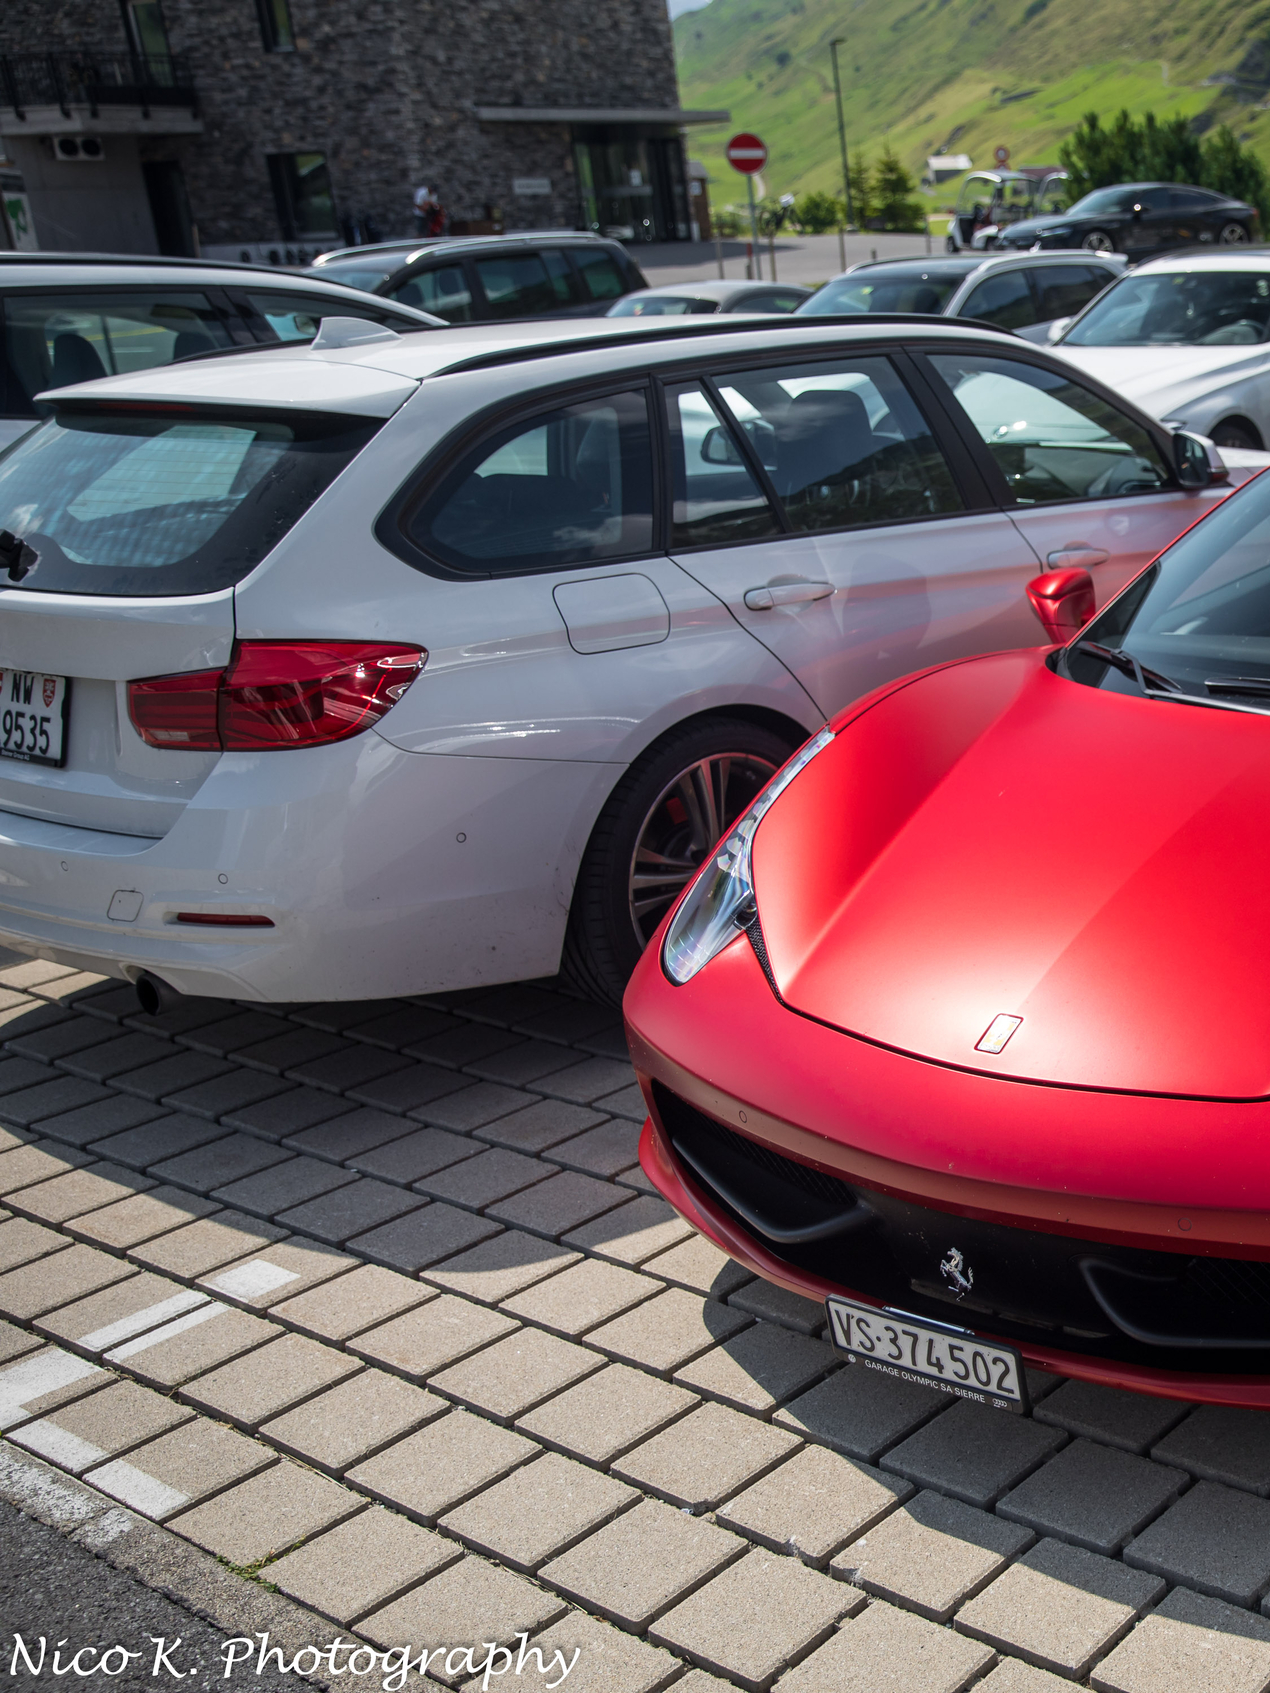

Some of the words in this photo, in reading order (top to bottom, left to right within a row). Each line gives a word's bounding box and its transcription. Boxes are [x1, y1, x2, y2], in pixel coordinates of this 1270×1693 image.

[11, 673, 35, 705] NW
[0, 709, 51, 755] 9535
[864, 1359, 900, 1377] GARAGE
[901, 1371, 939, 1389] OLYMPIC
[940, 1383, 953, 1393] SA
[954, 1386, 985, 1403] SIERRE
